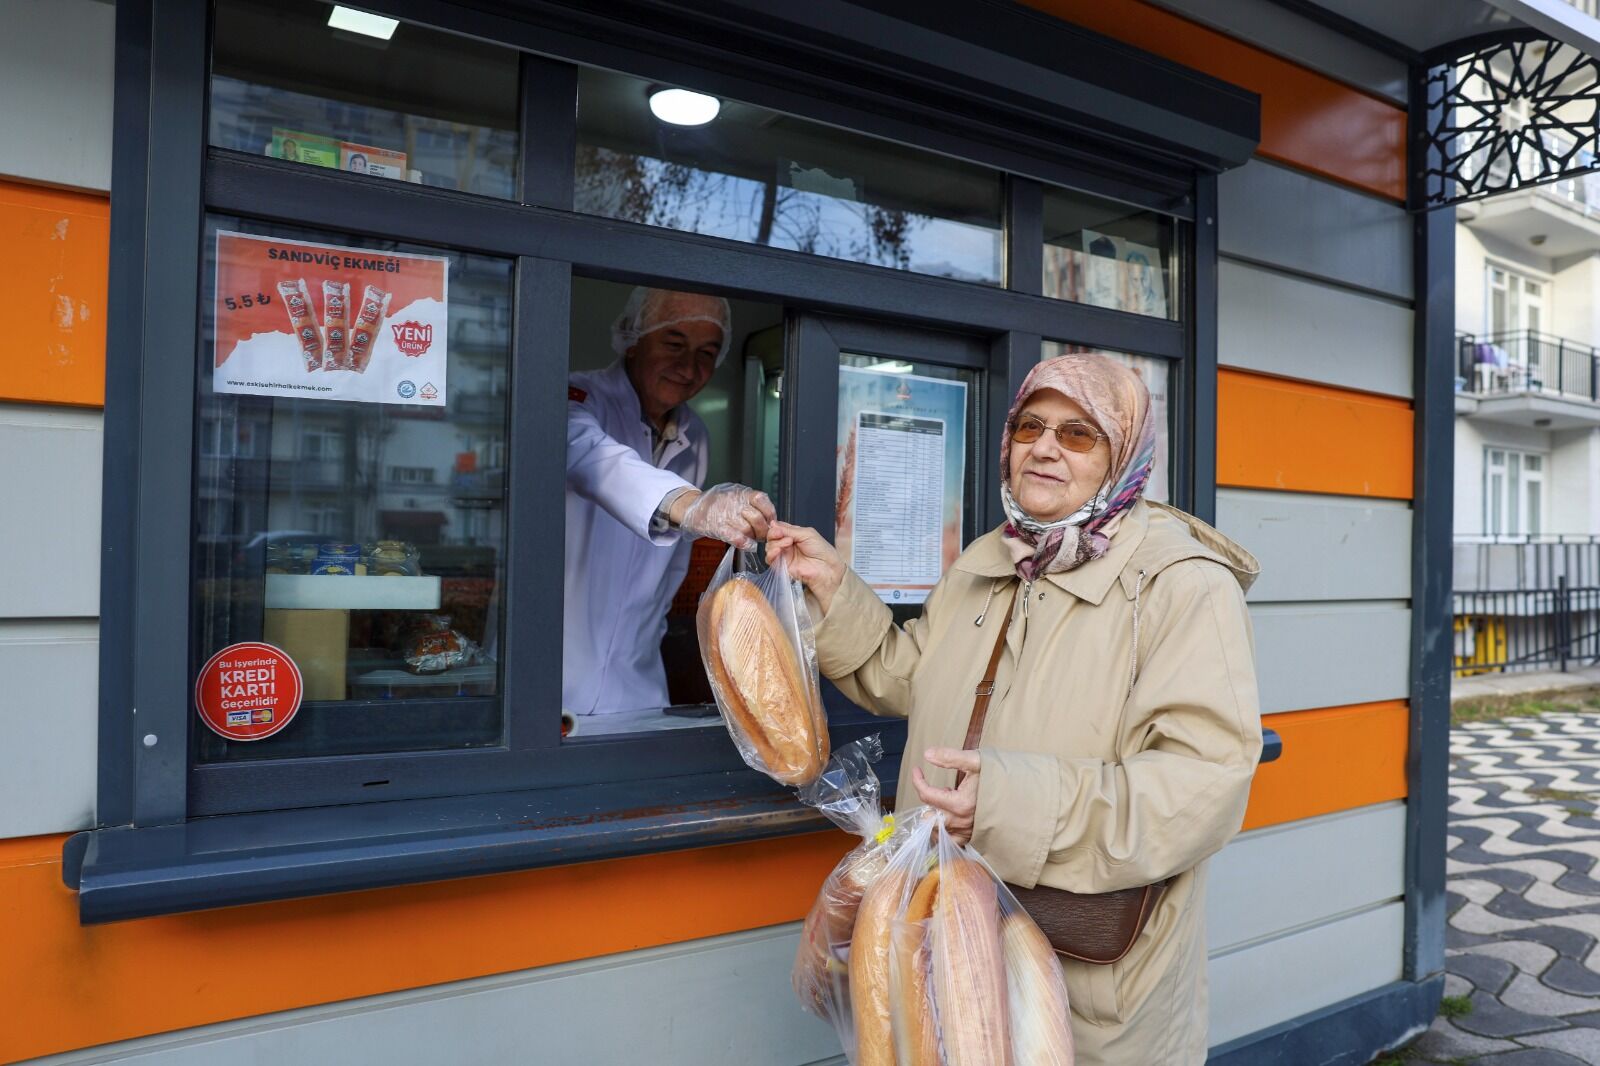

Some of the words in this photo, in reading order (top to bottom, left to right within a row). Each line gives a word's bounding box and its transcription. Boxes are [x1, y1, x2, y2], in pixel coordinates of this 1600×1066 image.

[268, 248, 340, 269] SANDVİÇ
[344, 258, 400, 273] EKMEĞİ
[224, 295, 253, 310] 5.5
[393, 325, 431, 342] YENİ
[401, 340, 423, 350] ÜRÜN
[220, 665, 276, 684] KREDİ
[221, 682, 276, 699] KARTI
[221, 696, 279, 709] Geçerlidir
